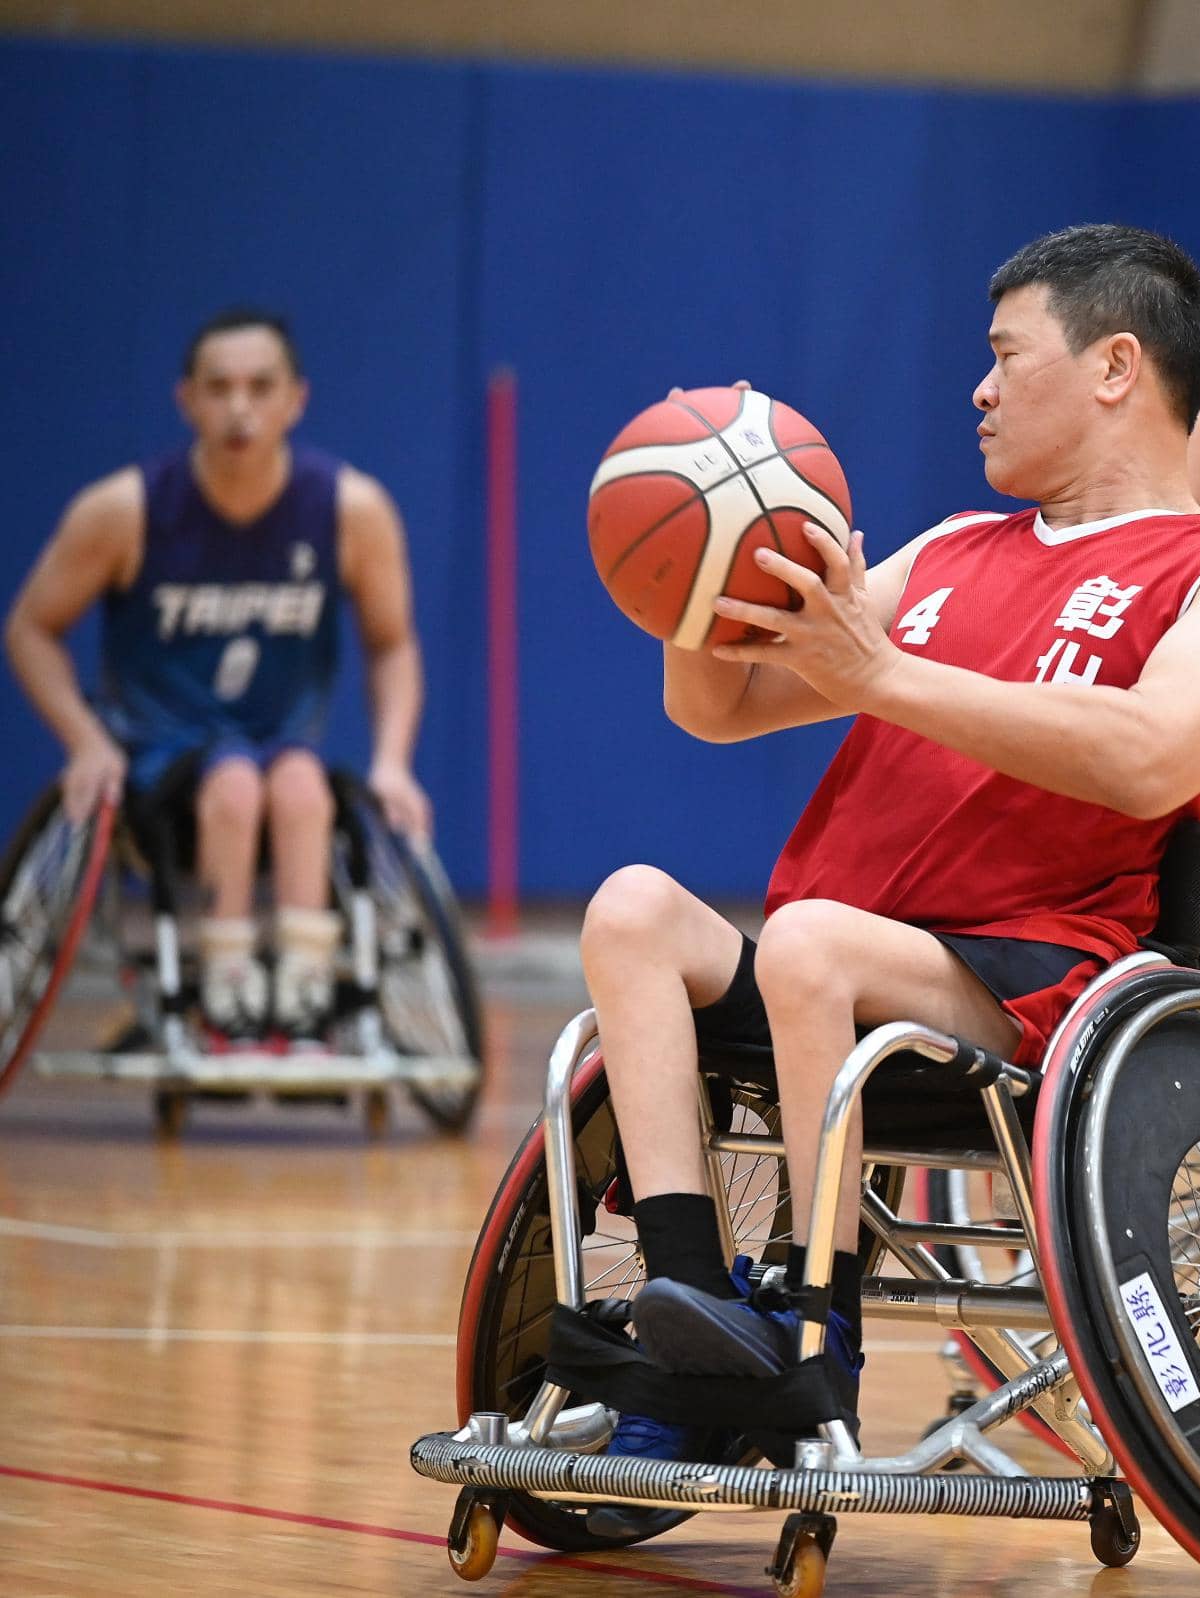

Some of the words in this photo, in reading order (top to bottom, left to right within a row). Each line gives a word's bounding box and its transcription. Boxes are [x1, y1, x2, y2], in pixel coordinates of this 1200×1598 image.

[154, 583, 325, 641] TAIPEI
[896, 587, 954, 645] 4
[1034, 575, 1144, 687] 彰化
[890, 1295, 915, 1303] JAPAN
[1126, 1284, 1189, 1399] 彰化縣
